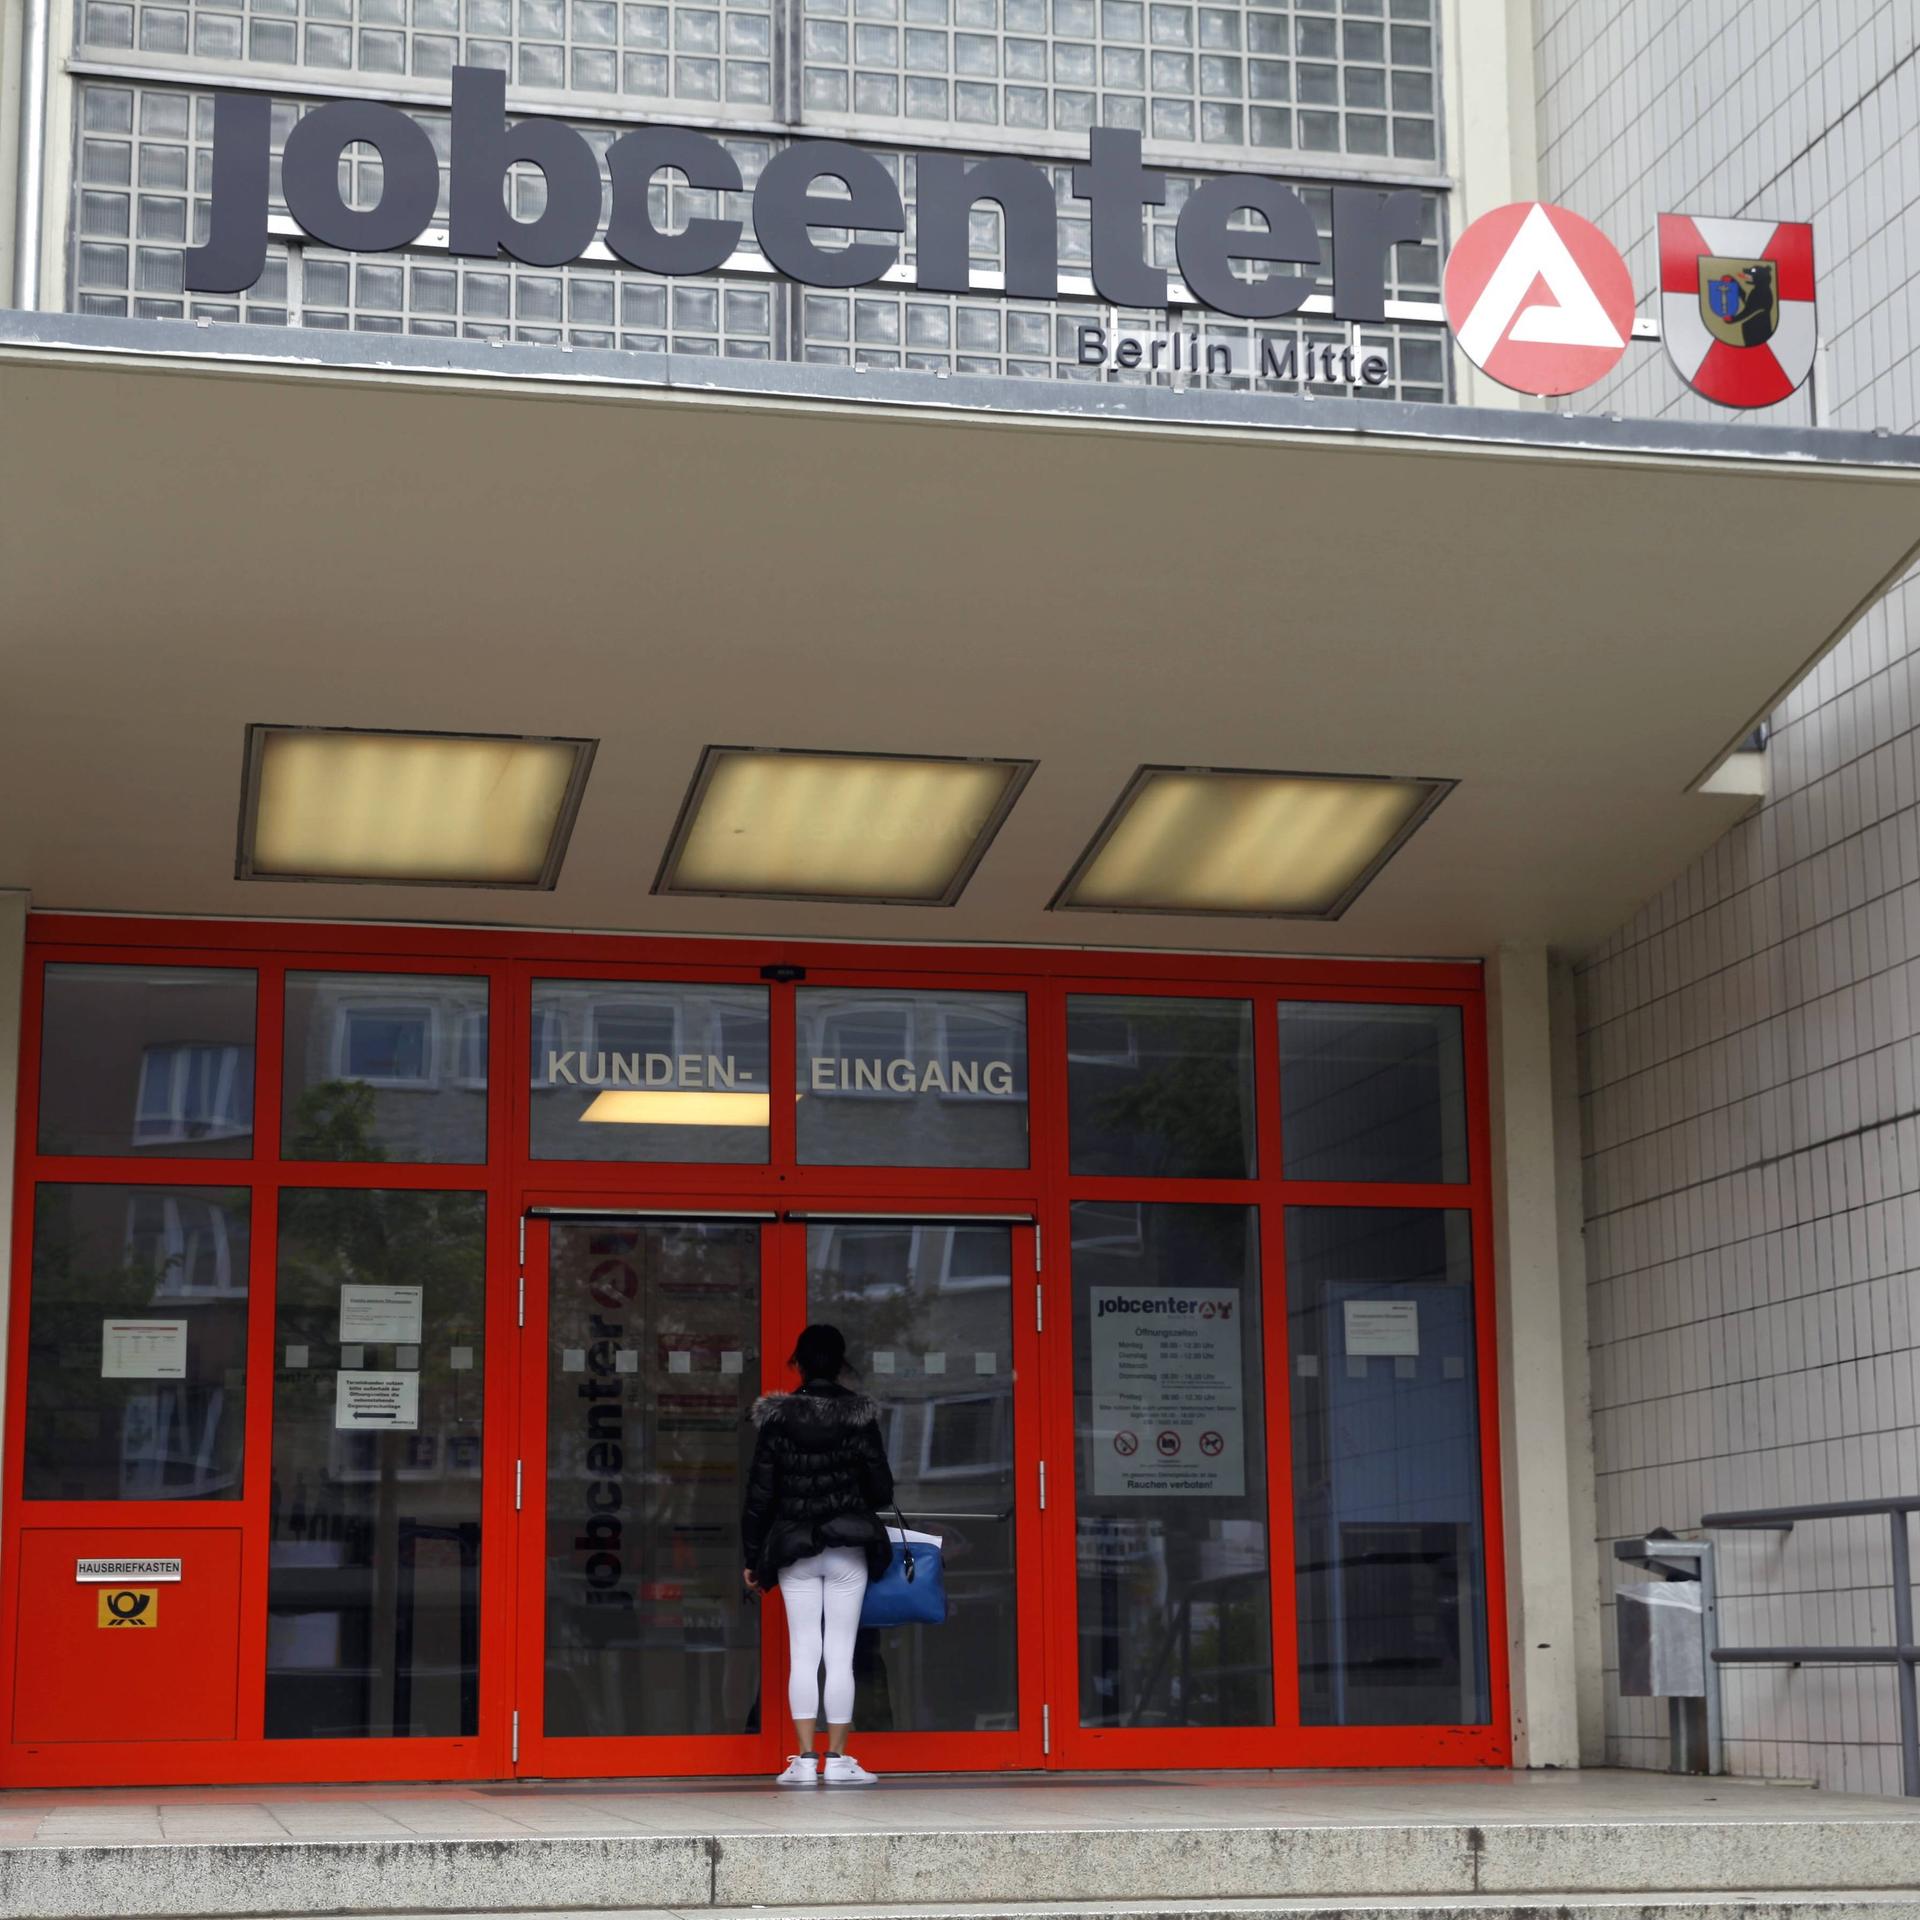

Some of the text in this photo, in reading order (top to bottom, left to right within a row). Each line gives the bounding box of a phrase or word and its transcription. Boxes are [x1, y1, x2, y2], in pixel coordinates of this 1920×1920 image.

[184, 66, 1423, 323] jobcenter
[1078, 326, 1388, 385] Berlin Mitte
[547, 1051, 1014, 1095] KUNDEN- EINGANG
[1098, 1296, 1198, 1317] jobcenter
[575, 1315, 633, 1610] jobcenter
[1128, 1480, 1213, 1489] Rauchen verboten!
[79, 1562, 180, 1574] HAUSBRIEFKASTEN
